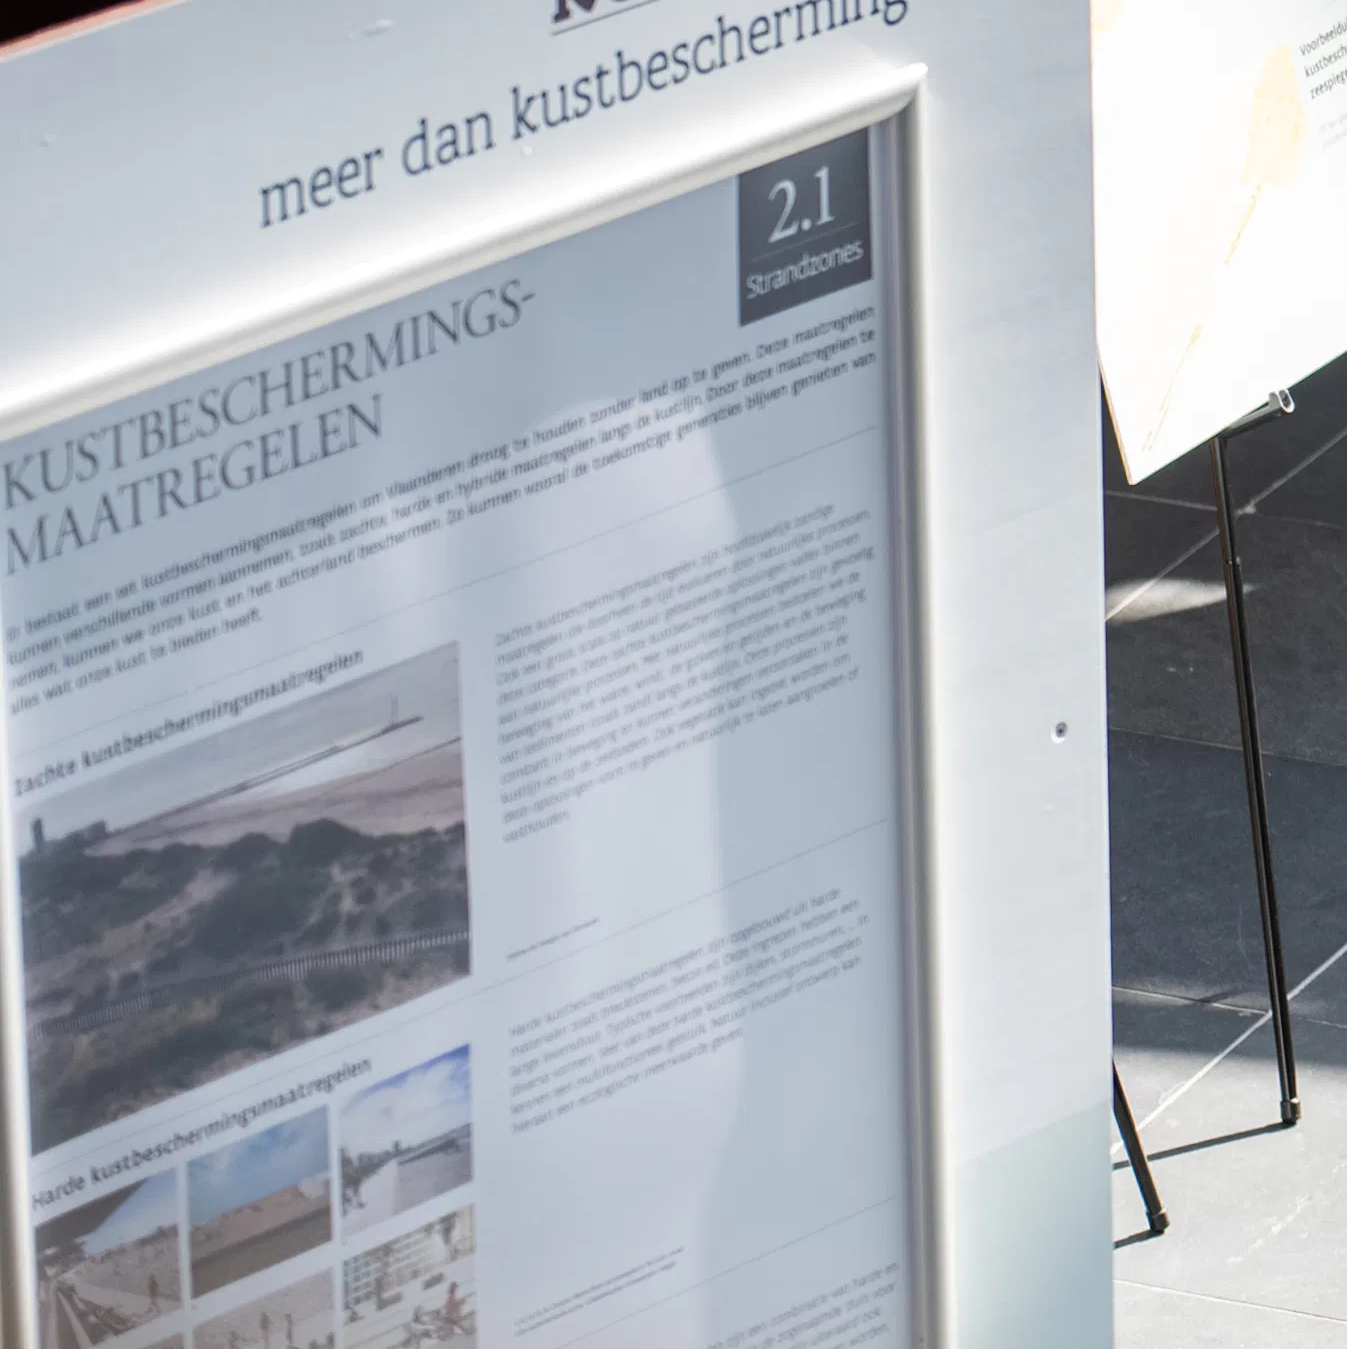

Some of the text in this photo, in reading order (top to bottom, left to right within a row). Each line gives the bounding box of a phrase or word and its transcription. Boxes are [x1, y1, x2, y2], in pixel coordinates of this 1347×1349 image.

[257, 146, 385, 229] meer
[401, 112, 497, 179] dan
[769, 164, 835, 245] 2.1
[745, 235, 864, 299] Strandzones
[4, 278, 536, 511] KUSTBESCHERMINGS-
[5, 392, 384, 577] MAATREGELEN
[31, 1167, 87, 1211] Harde
